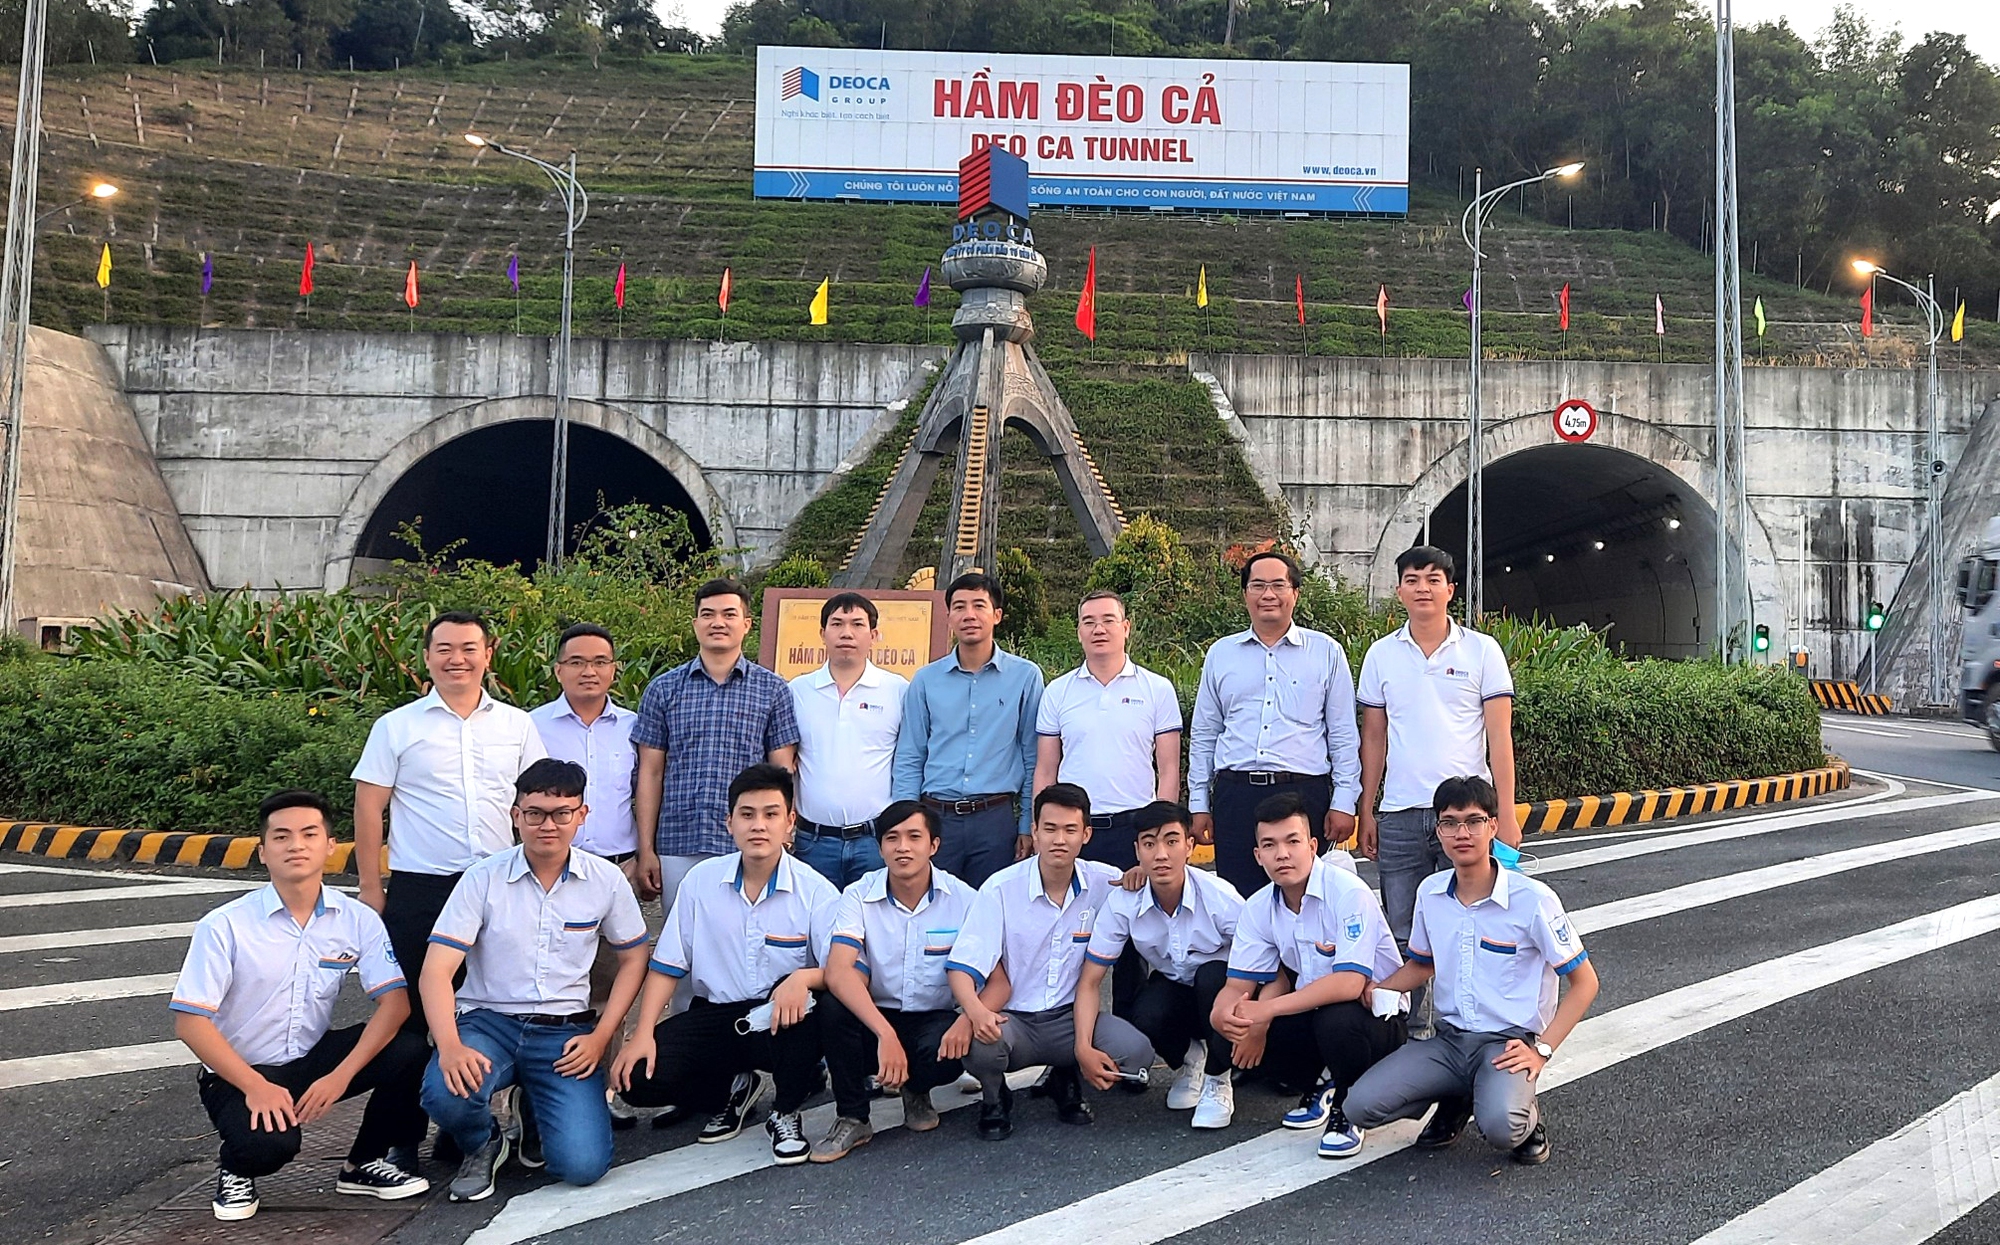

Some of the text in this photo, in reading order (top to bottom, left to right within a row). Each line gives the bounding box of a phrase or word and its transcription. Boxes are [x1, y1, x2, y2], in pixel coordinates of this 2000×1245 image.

[829, 76, 891, 90] DEOCA
[933, 66, 1222, 125] HẦM ĐÈO CẢ
[831, 96, 887, 105] GROUP
[971, 133, 1194, 163] DEO CA TUNNEL
[844, 179, 883, 191] CHÚNG
[887, 180, 904, 191] TÔI
[906, 181, 935, 192] LUÔN
[937, 180, 954, 193] NỖ
[1030, 183, 1062, 195] SỐNG
[1065, 187, 1080, 195] AN
[1083, 185, 1112, 196] TOÀN
[1115, 188, 1140, 197] CHO
[1142, 188, 1168, 198] CON
[1170, 187, 1207, 200] NGƯỜI,
[1210, 187, 1230, 199] ĐẤT
[1232, 188, 1264, 200] NƯỚC
[1267, 189, 1289, 203] VIỆT
[1291, 192, 1316, 201] NAM
[952, 220, 1035, 246] DEOCA
